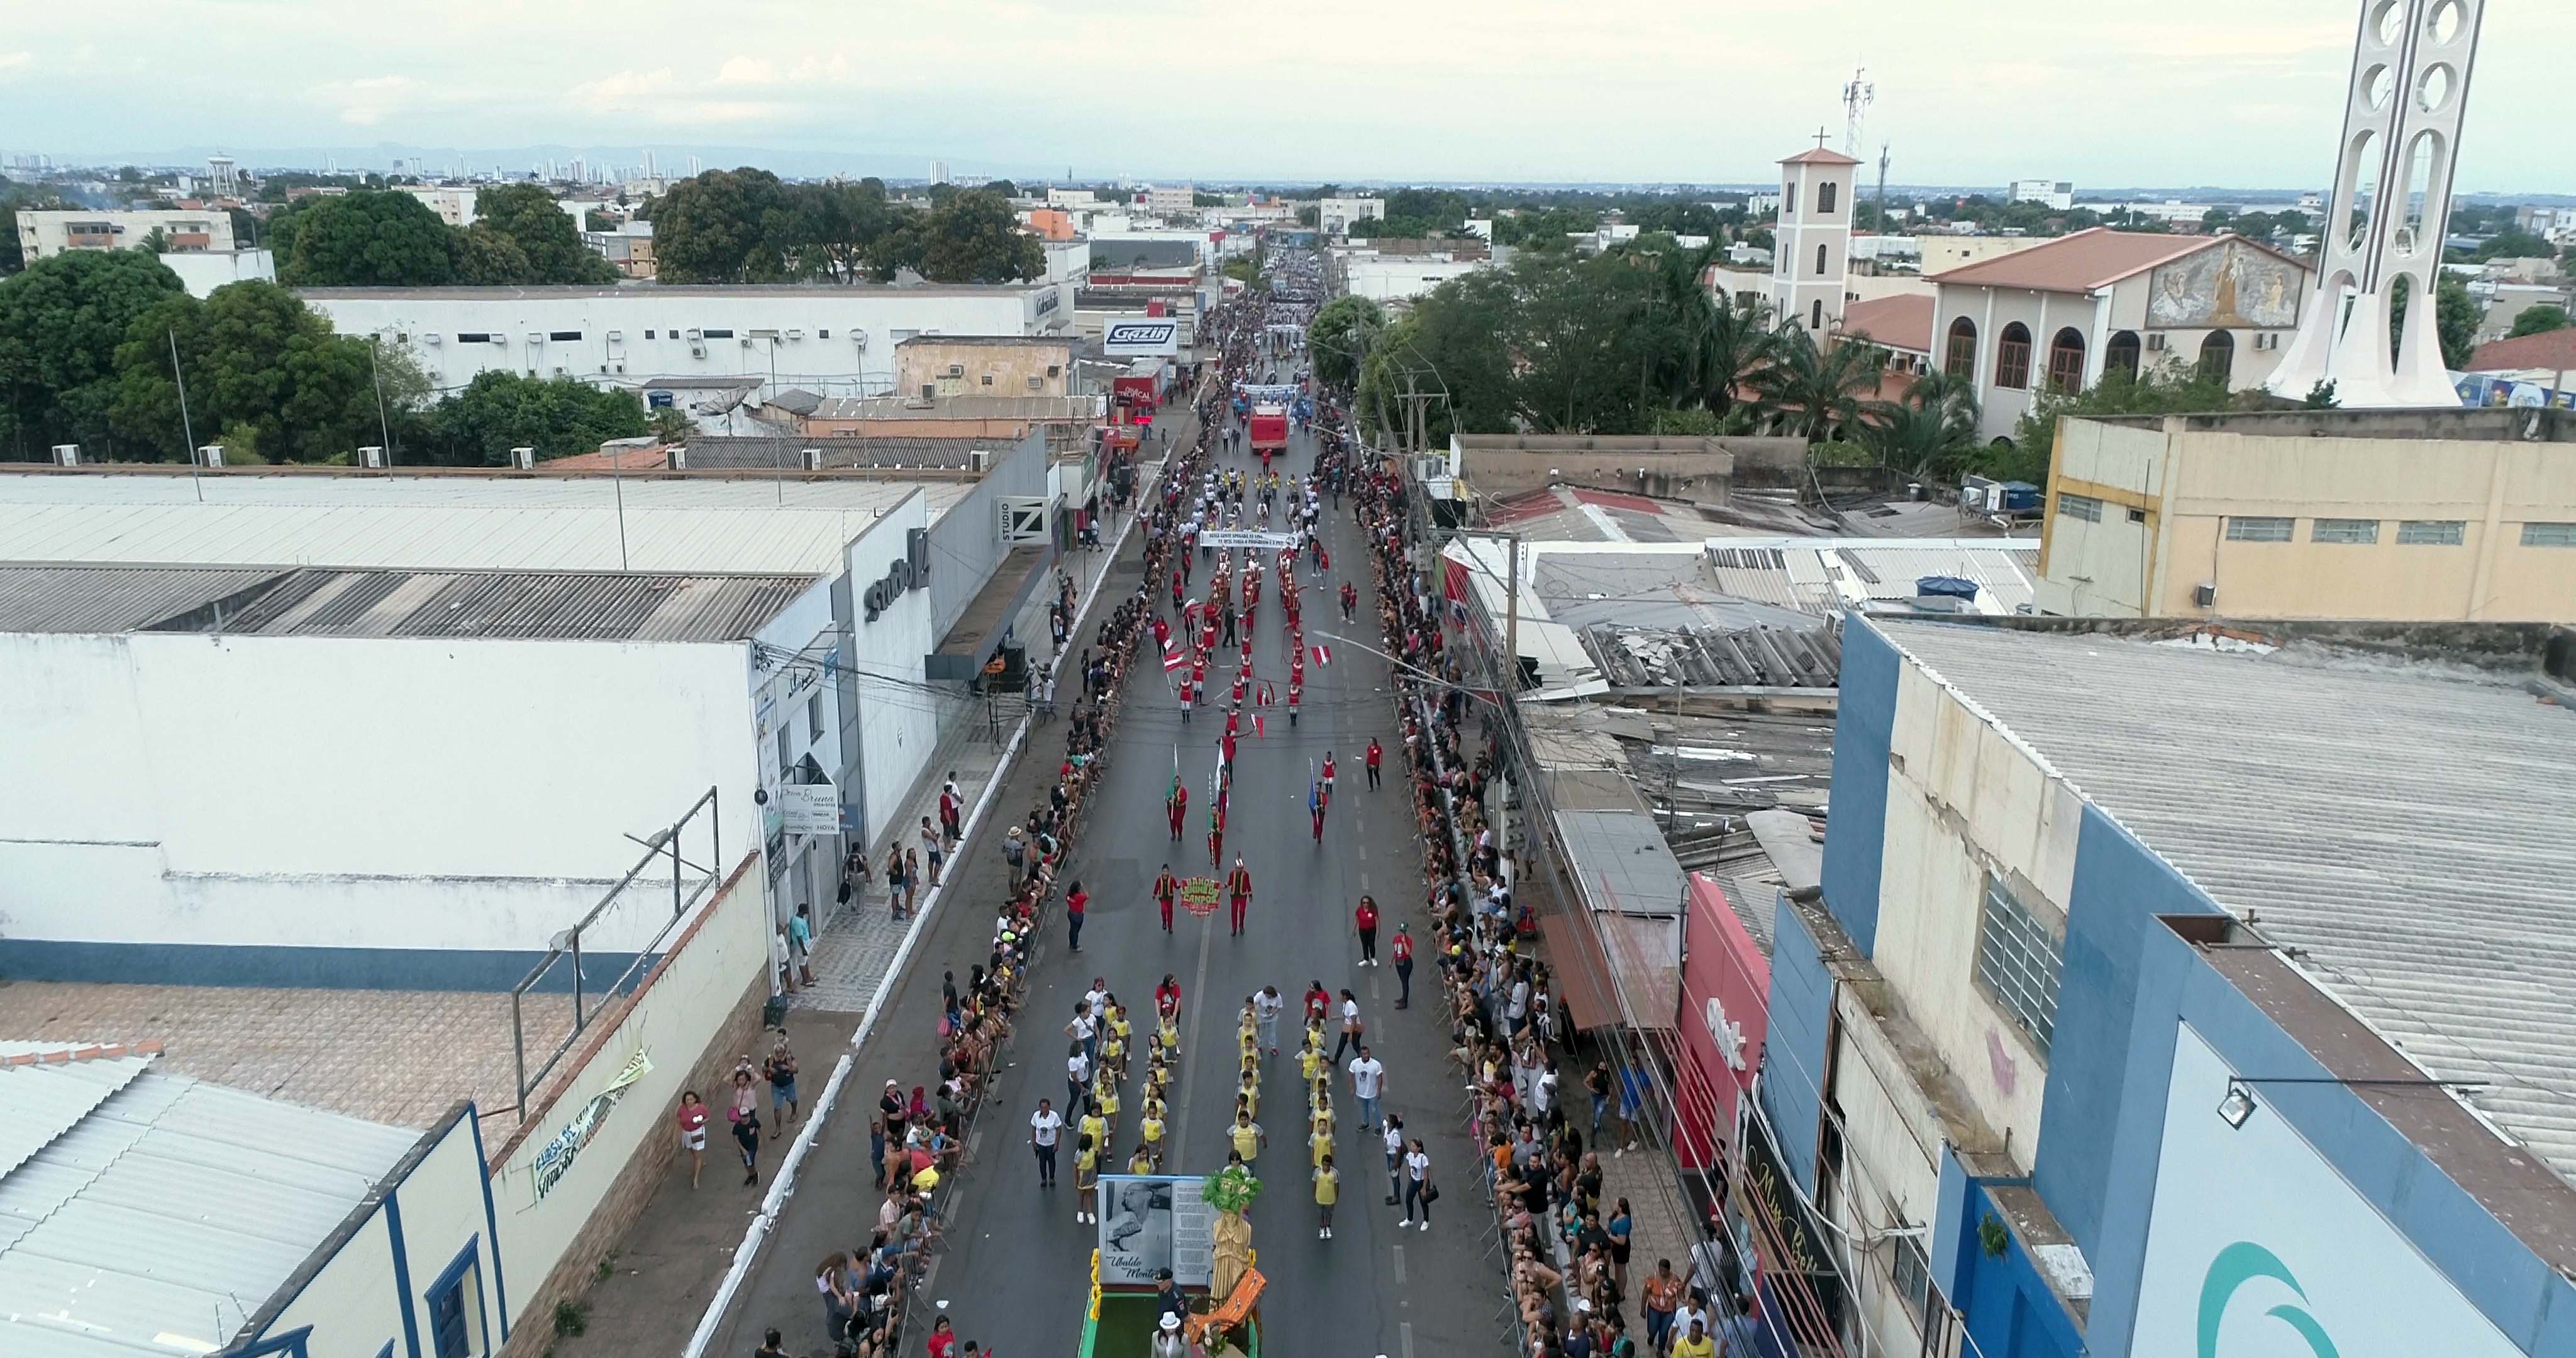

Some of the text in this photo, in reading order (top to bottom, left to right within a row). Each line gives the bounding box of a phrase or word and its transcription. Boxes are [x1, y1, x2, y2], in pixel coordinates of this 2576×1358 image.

[1113, 326, 1172, 341] GAZIN
[1002, 502, 1043, 541] STUDIO Z
[863, 558, 912, 624] Studio
[536, 1124, 576, 1171] CURSO DE
[1106, 1256, 1141, 1267] Ubaldo
[1122, 1267, 1157, 1278] Monte
